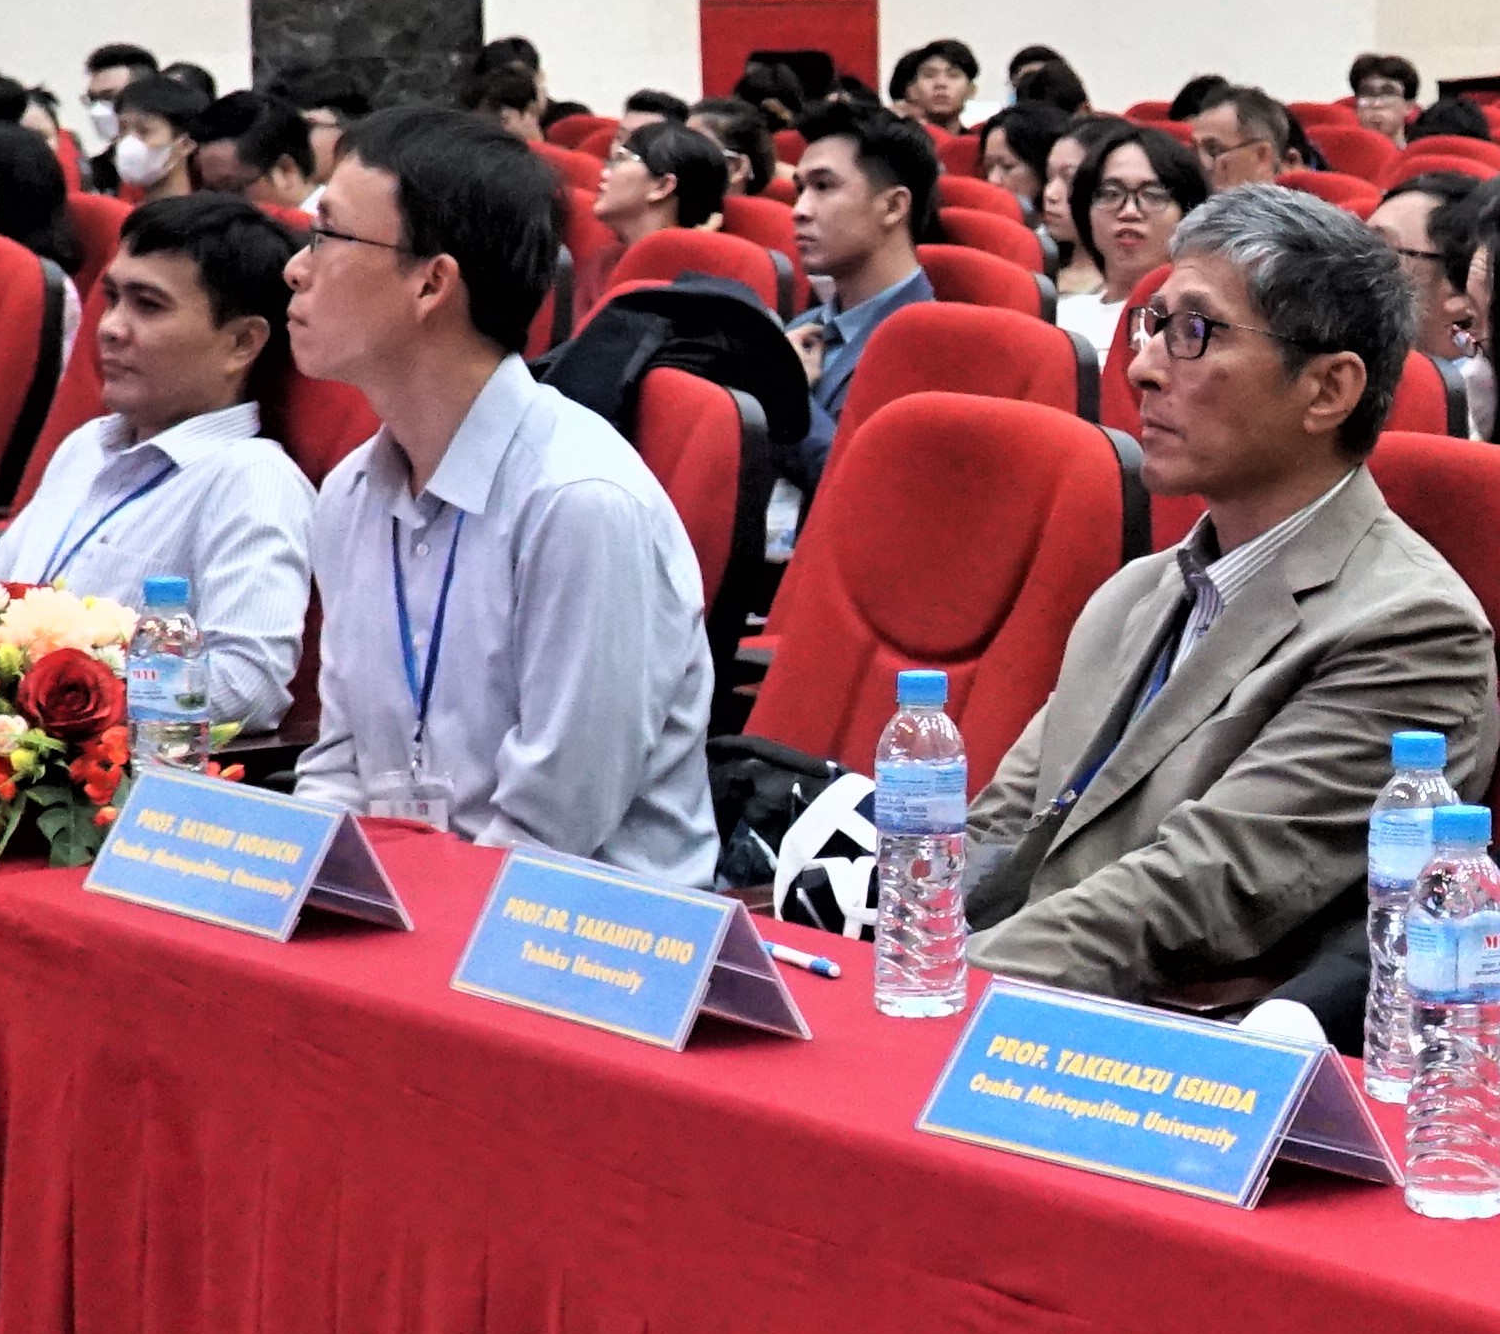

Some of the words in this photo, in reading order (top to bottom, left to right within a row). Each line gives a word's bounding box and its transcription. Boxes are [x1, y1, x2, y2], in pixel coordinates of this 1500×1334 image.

[521, 940, 571, 971] Tohoku
[571, 954, 647, 995] University
[573, 914, 653, 953] TAKAHITO
[654, 936, 696, 965] ONO
[986, 1036, 1048, 1070] PROF.
[1053, 1050, 1174, 1094] TAKEKAZU
[1174, 1074, 1258, 1115] ISHIDA
[969, 1073, 1022, 1102] Osaka
[1024, 1087, 1138, 1128] Metropolitan
[1142, 1112, 1238, 1153] University
